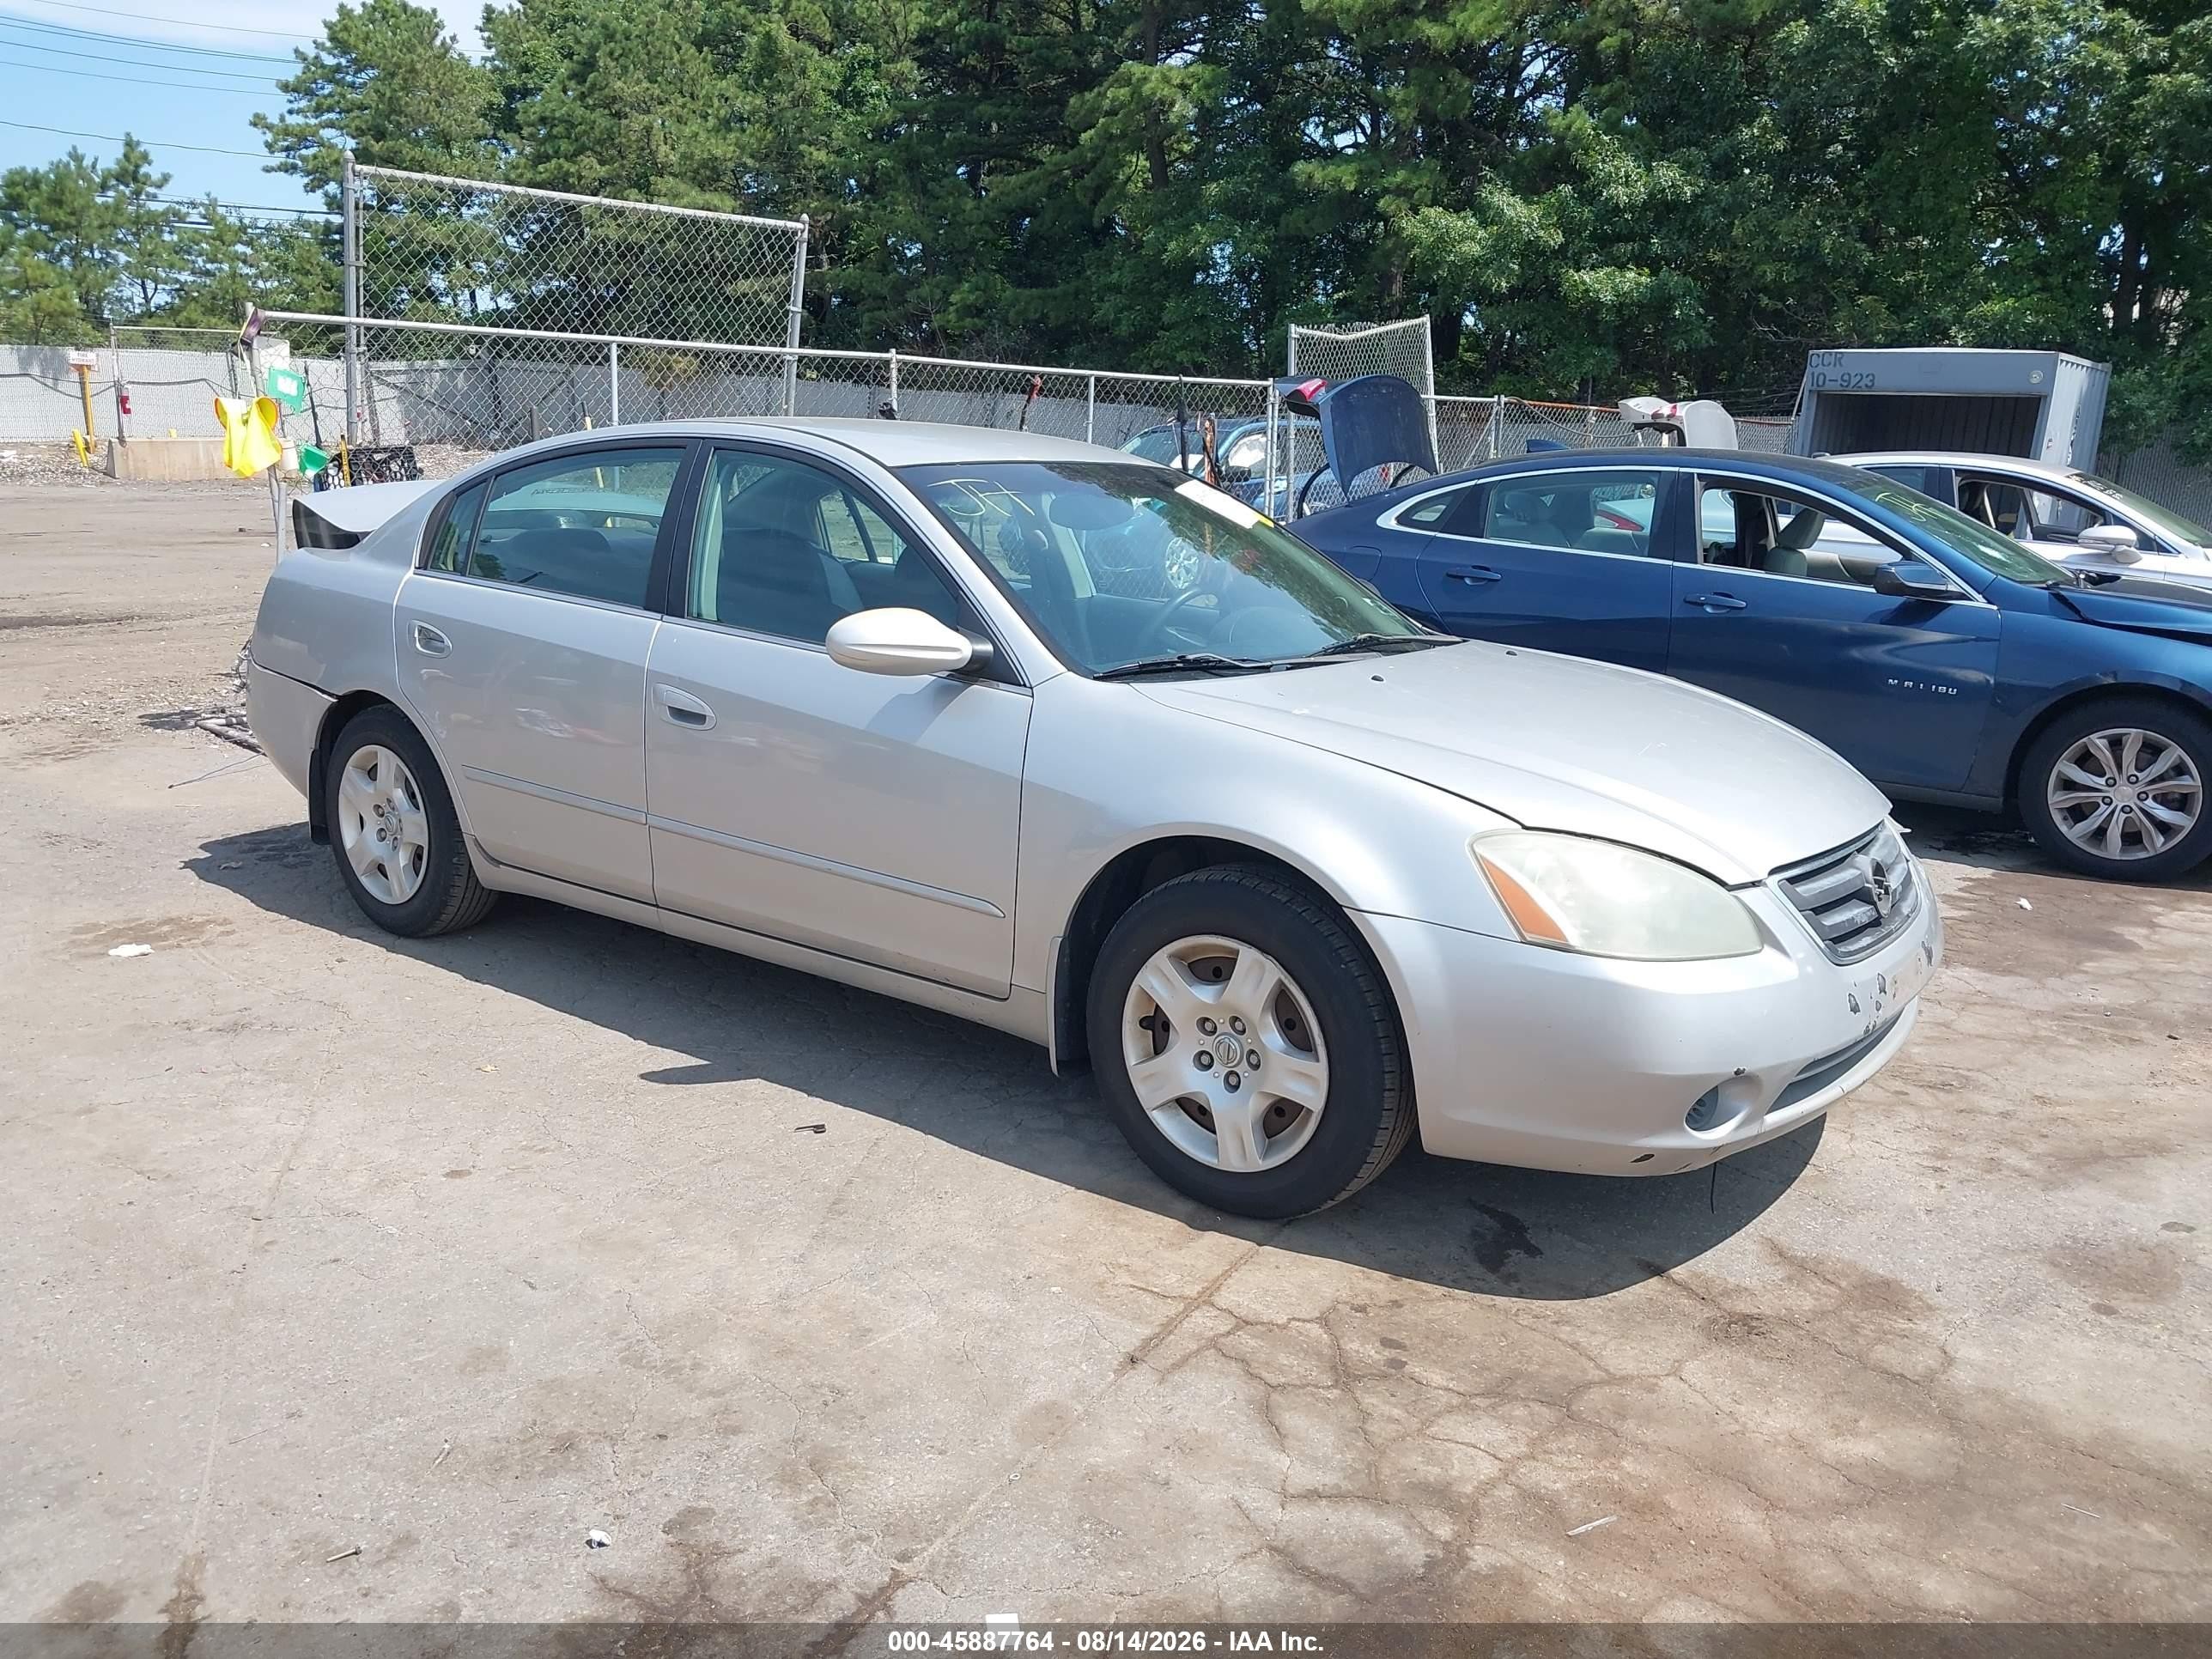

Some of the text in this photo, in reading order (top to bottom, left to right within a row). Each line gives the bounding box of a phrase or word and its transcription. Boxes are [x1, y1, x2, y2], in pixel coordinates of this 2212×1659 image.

[1808, 353, 1844, 368] CCR
[1810, 371, 1876, 389] 10-923
[927, 478, 1036, 517] JH
